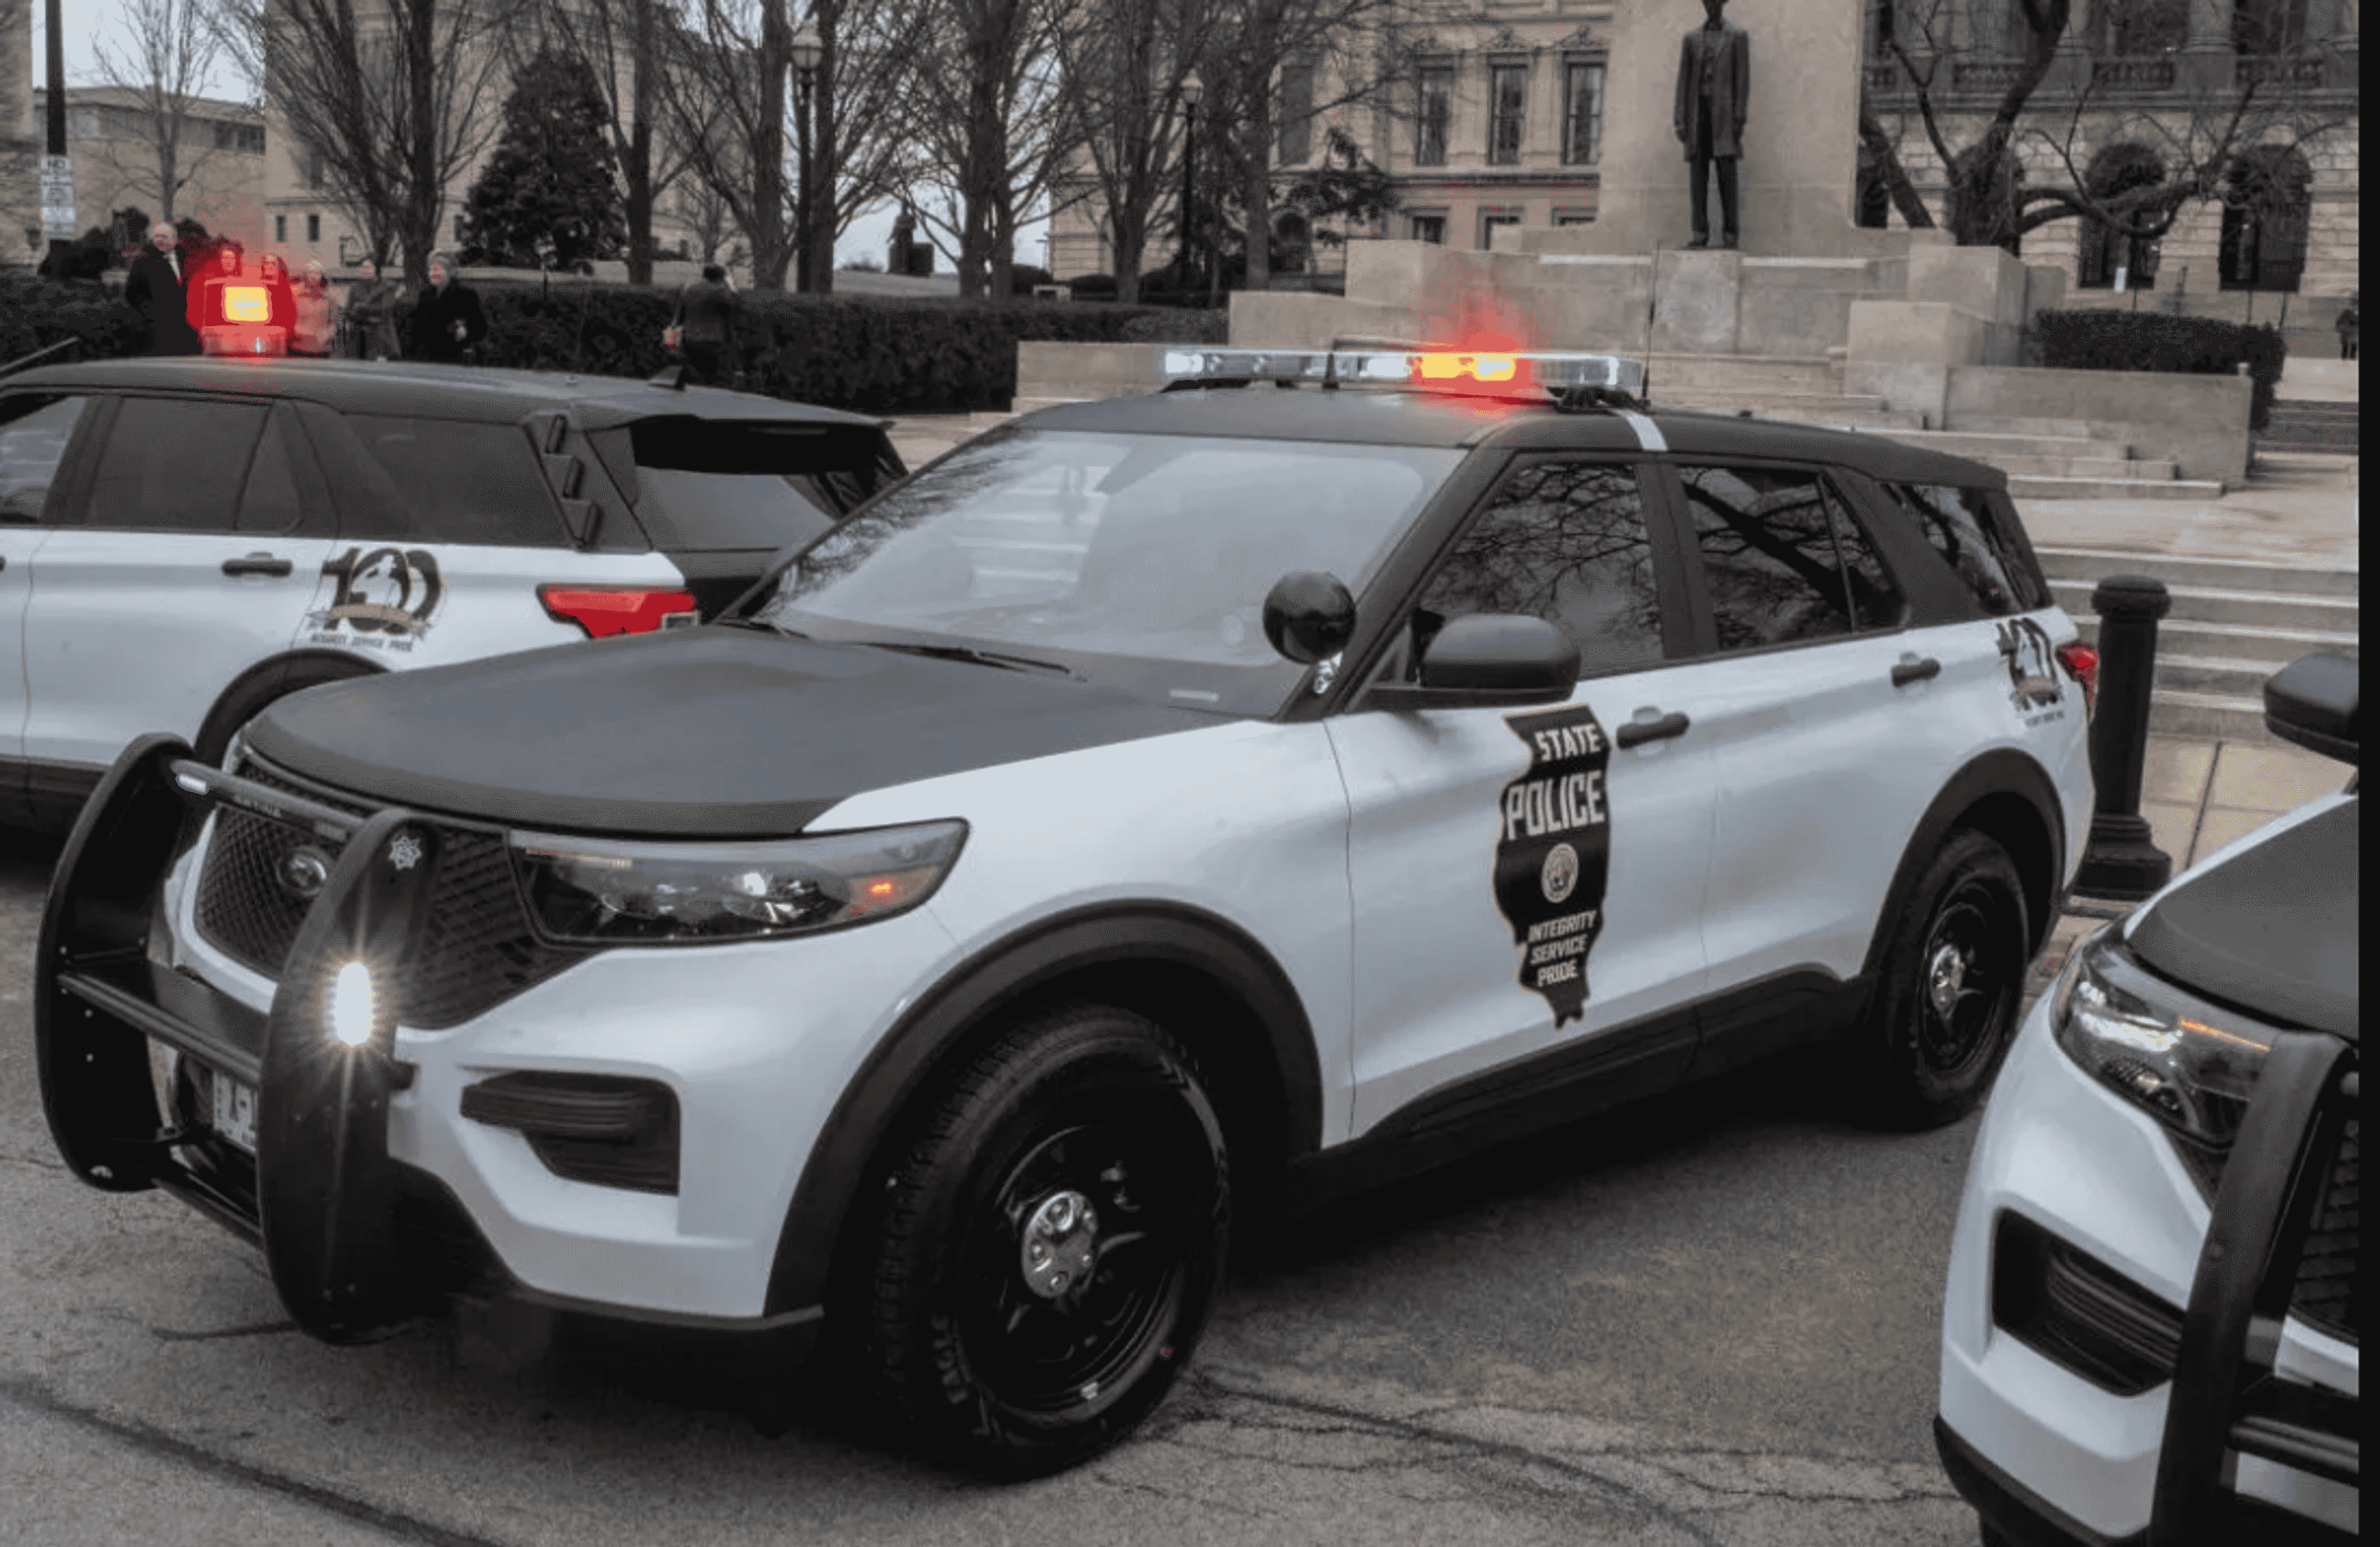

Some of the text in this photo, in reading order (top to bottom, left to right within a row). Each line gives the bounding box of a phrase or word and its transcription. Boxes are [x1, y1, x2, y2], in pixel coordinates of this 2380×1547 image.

[1535, 724, 1601, 762] STATE
[1507, 770, 1605, 841] POLICE
[1528, 909, 1598, 943] INTEGRITY
[1530, 933, 1589, 966] SERVICE
[1538, 958, 1579, 987] PRIDE
